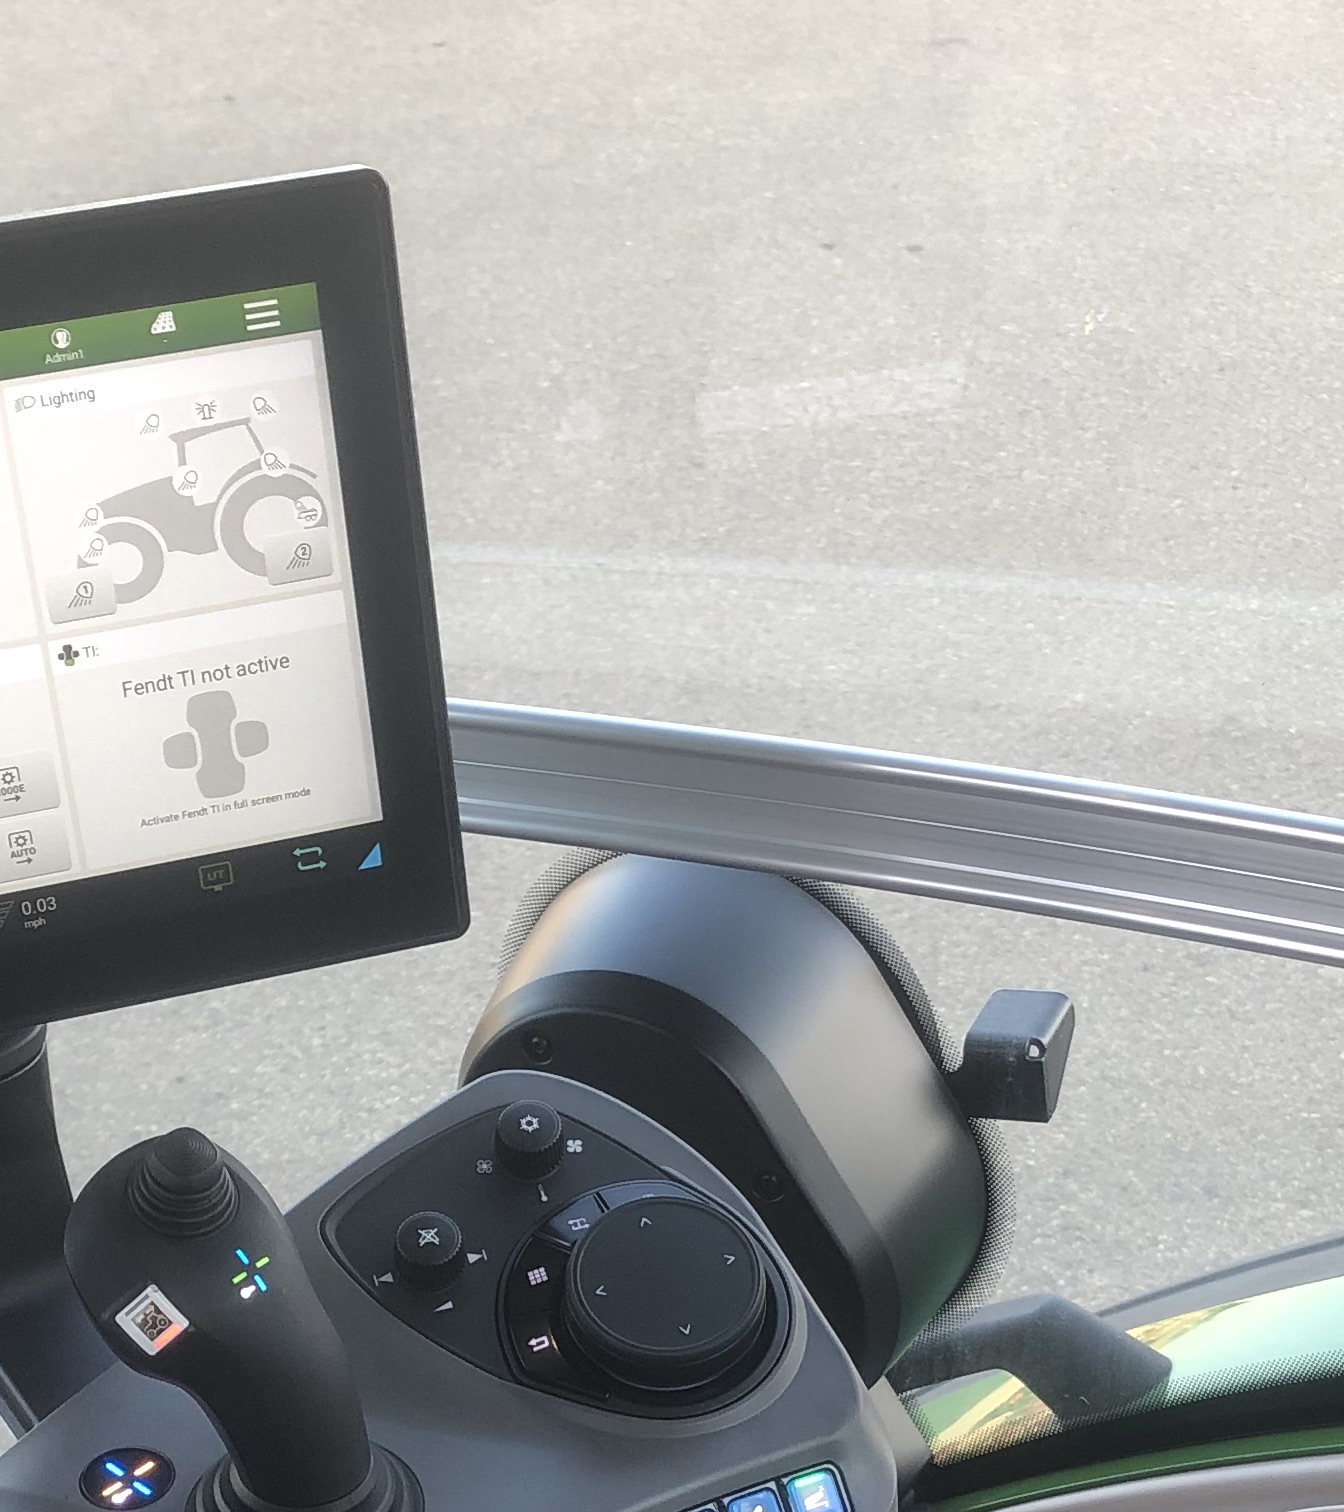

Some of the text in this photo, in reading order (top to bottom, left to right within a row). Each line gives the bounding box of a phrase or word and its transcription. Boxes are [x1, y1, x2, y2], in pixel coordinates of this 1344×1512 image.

[44, 349, 84, 365] Admin1
[40, 388, 95, 408] Lighting
[82, 645, 99, 659] TI:
[122, 655, 291, 698] Fendt TI not active
[140, 787, 312, 828] Activate Fendt TI in full screen mode
[10, 846, 37, 860] AUTO
[21, 896, 57, 916] 0.03
[24, 917, 47, 931] mph
